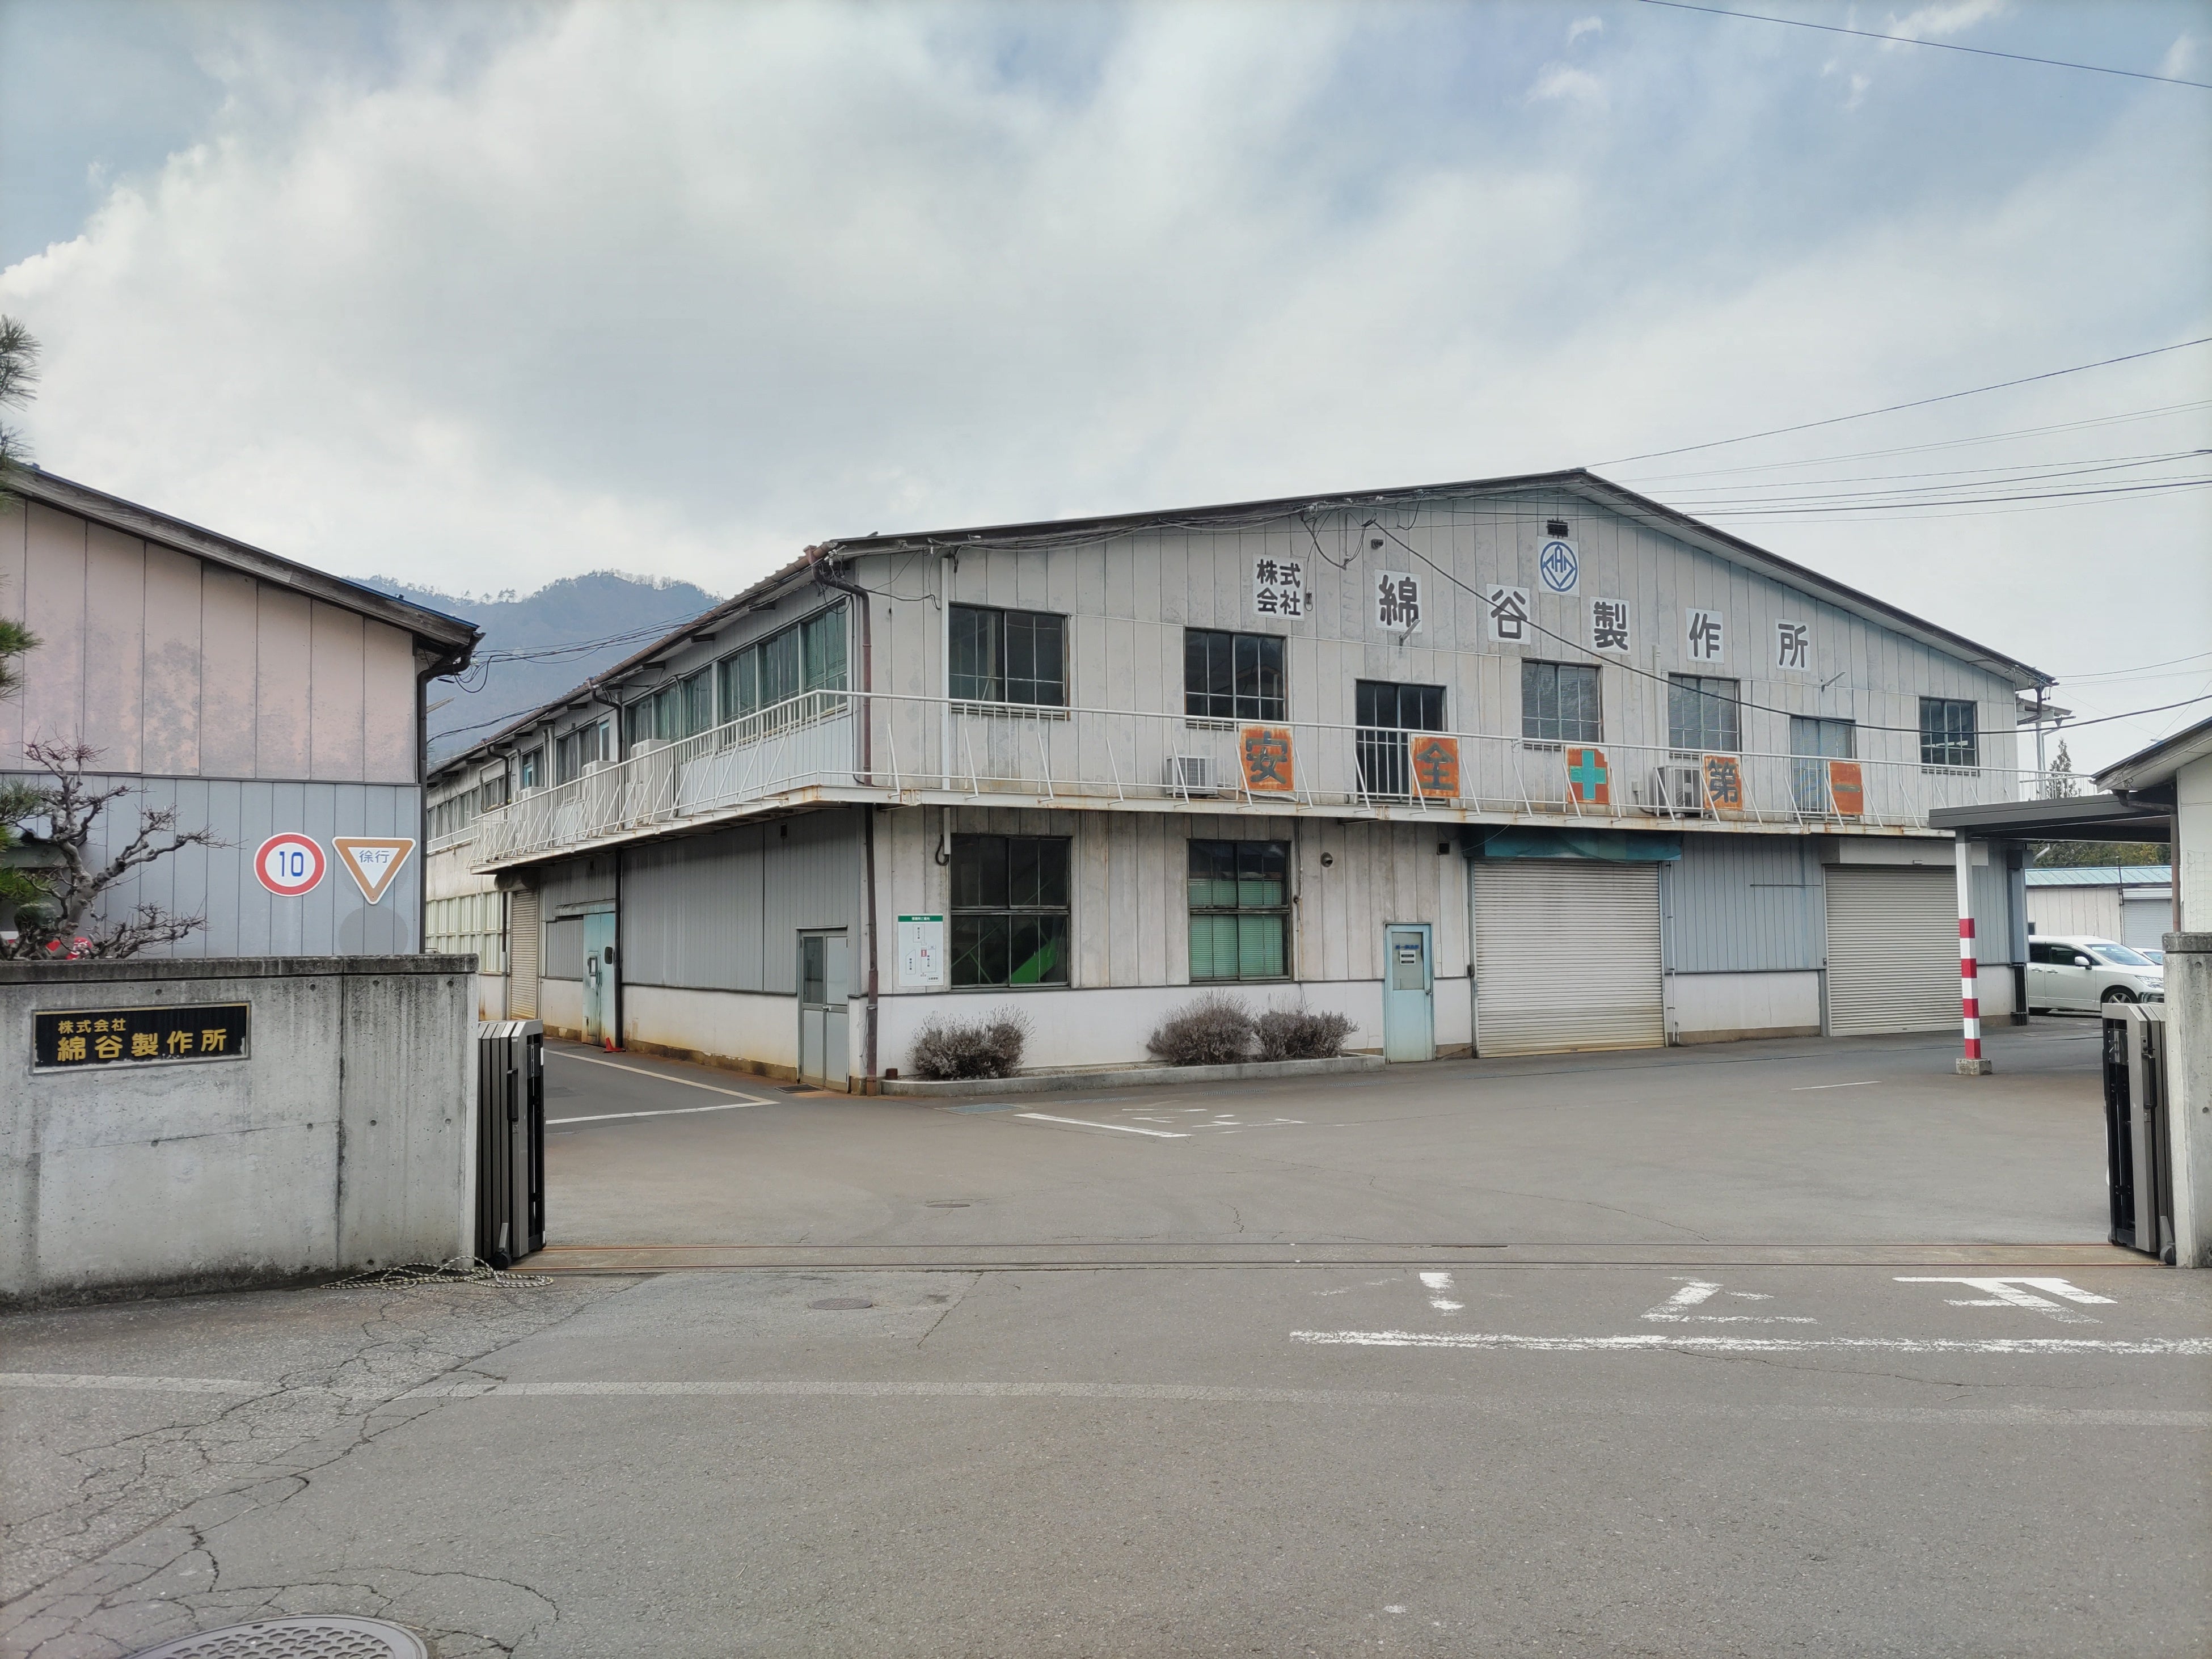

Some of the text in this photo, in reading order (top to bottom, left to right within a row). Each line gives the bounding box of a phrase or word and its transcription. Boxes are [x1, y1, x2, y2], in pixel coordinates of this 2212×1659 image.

[1256, 559, 1301, 588] 株式
[1256, 587, 1301, 616] 会社
[1379, 575, 1808, 668] 綿谷製作所
[279, 851, 304, 877] 10
[359, 850, 390, 863] 徐行
[58, 1018, 126, 1034] 株式会社
[57, 1028, 226, 1062] 綿谷製作所
